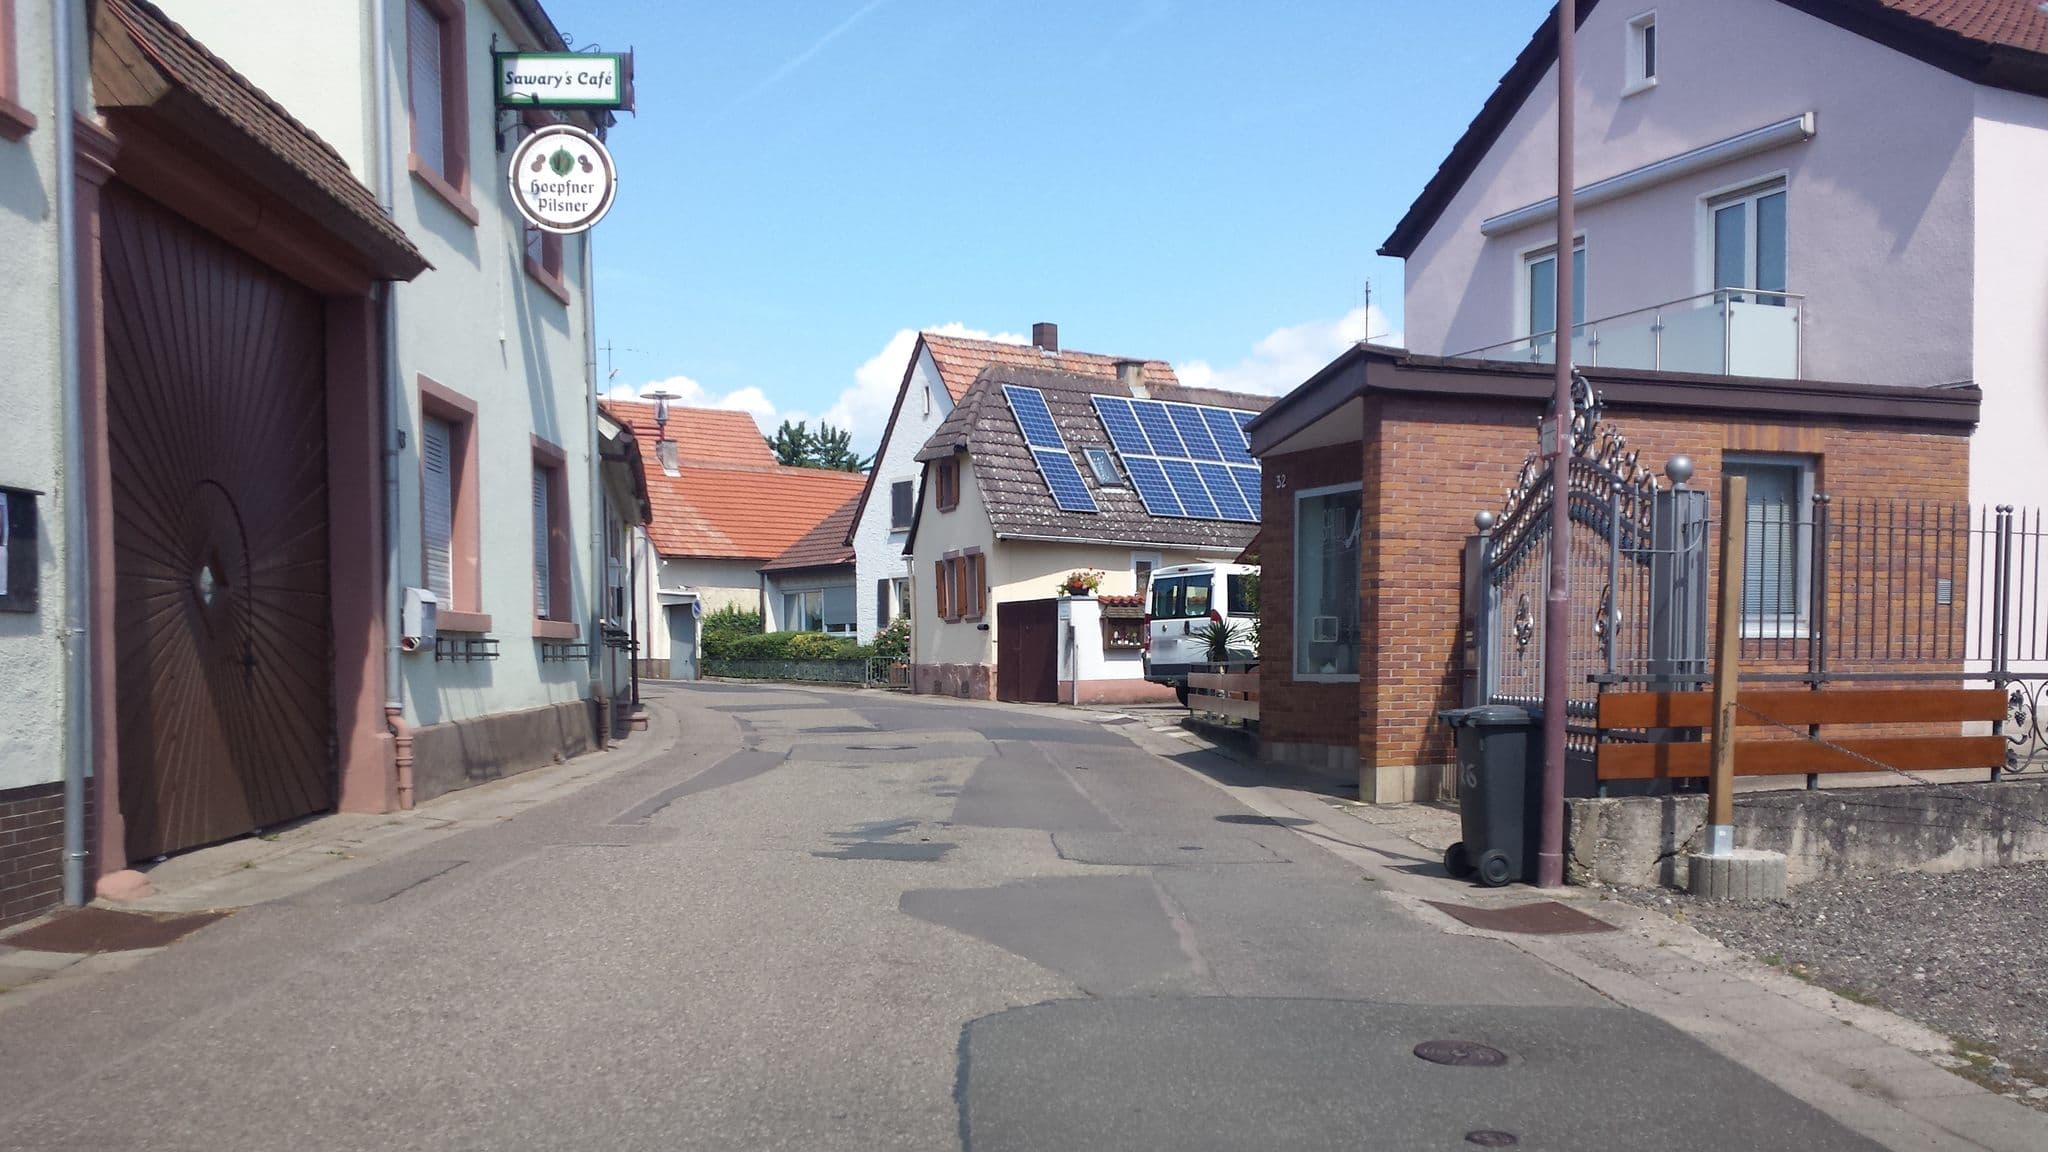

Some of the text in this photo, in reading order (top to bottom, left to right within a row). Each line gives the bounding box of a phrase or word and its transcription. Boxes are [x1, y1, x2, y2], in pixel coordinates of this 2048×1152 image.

[505, 70, 612, 88] Sawary's Café
[530, 179, 595, 196] Hoepfner
[538, 198, 588, 212] Pilsner
